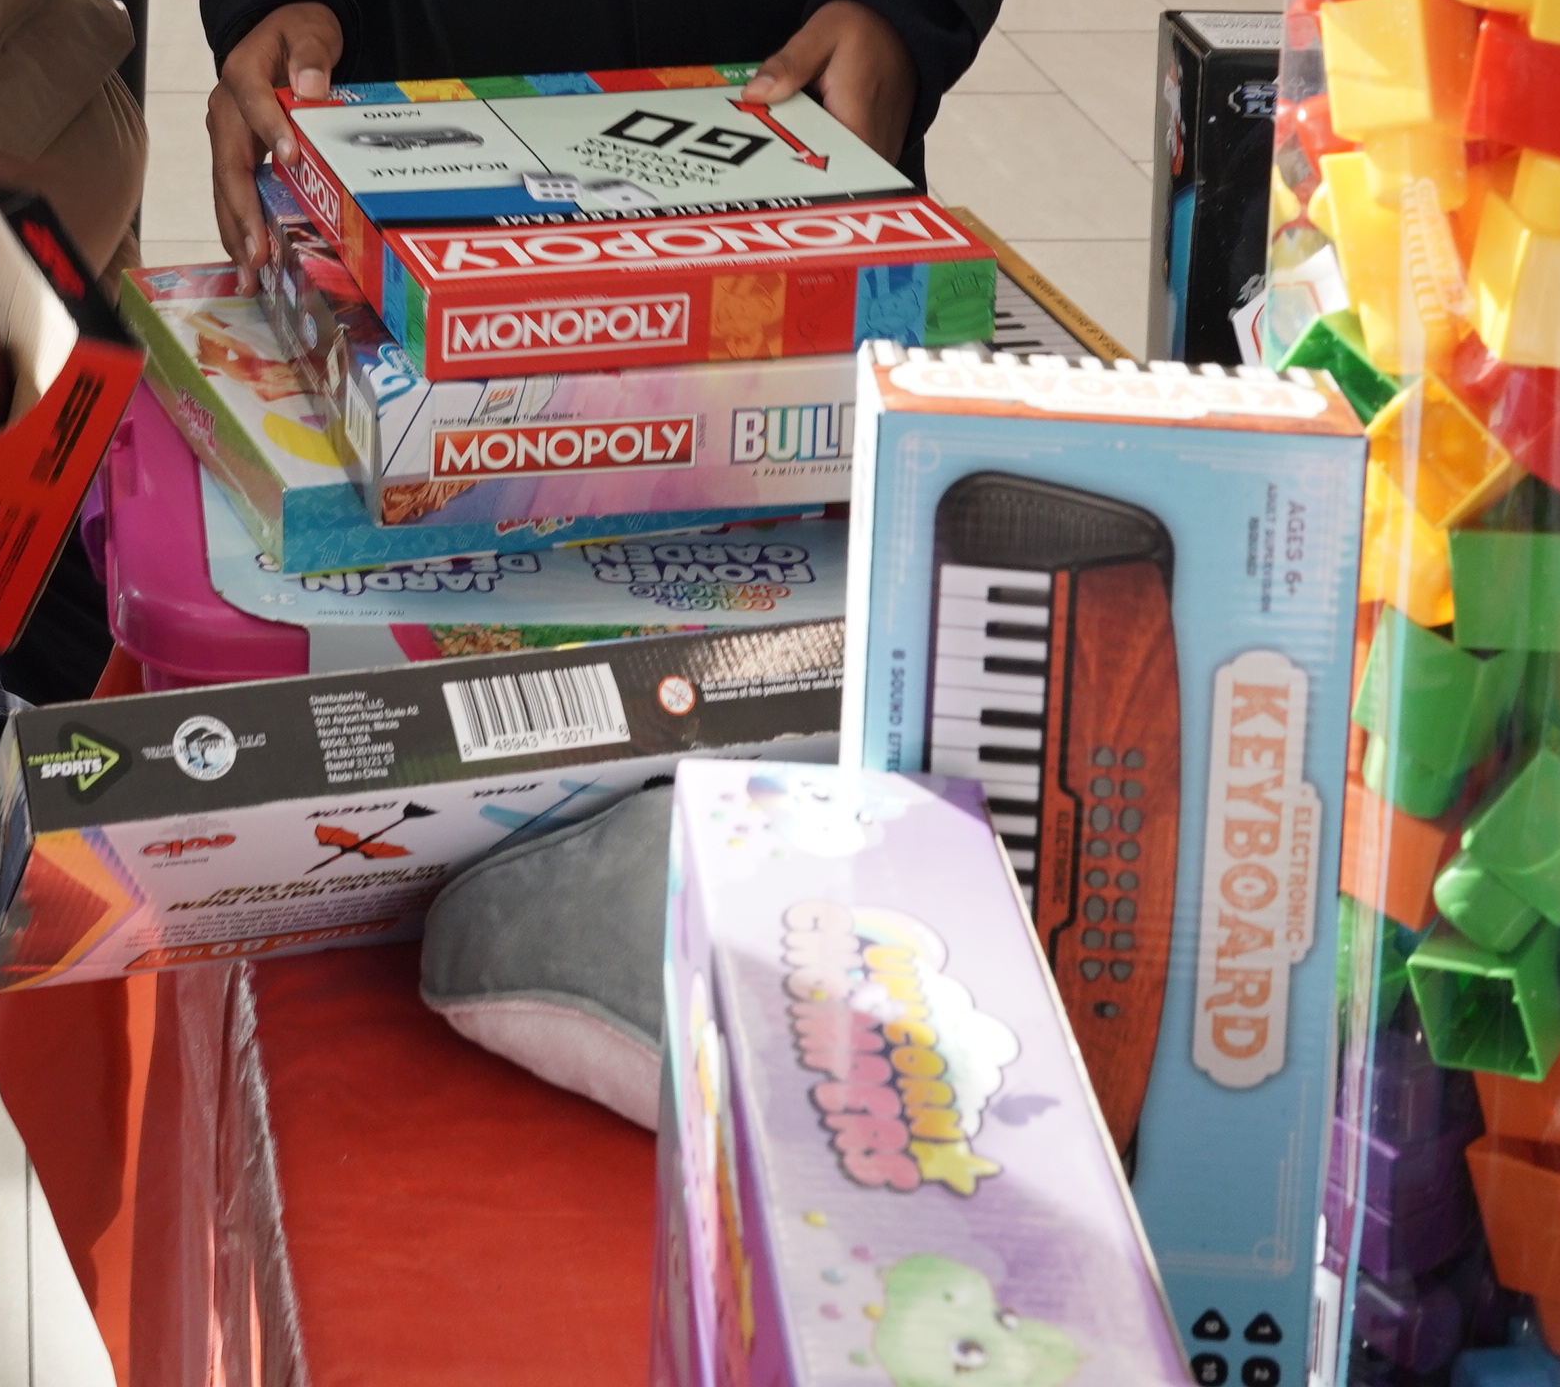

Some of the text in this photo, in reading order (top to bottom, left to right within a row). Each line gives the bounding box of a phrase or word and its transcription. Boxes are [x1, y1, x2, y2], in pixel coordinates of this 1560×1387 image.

[601, 109, 774, 166] GO
[366, 161, 510, 178] BOARDWALK
[765, 195, 812, 210] THE
[493, 212, 566, 228] GAME
[571, 207, 657, 224] BOARD
[441, 210, 935, 272] MONOPOLY
[452, 301, 682, 353] MONOPOLY
[920, 366, 1296, 408] KEYBOARD
[439, 422, 689, 474] MONOPOLY
[1285, 500, 1307, 564] AGES
[581, 542, 813, 566] GARDEN
[593, 560, 819, 586] FLOWER
[797, 670, 819, 682] under
[309, 691, 354, 707] Distributed
[703, 690, 739, 703] because
[763, 683, 799, 698] potential
[811, 678, 835, 690] small
[889, 664, 905, 726] SOUND
[462, 744, 473, 756] 8
[493, 736, 540, 753] 48943
[551, 728, 595, 745] 13017
[40, 758, 103, 779] SPORTS
[327, 771, 352, 784] Made
[362, 767, 389, 779] China
[304, 800, 397, 821] DRAGON
[1205, 679, 1290, 1062] KEYBOARD
[1285, 804, 1314, 954] ELECTRONIC
[166, 896, 240, 912] THEM
[241, 885, 326, 905] WATCH
[209, 938, 270, 958] 80
